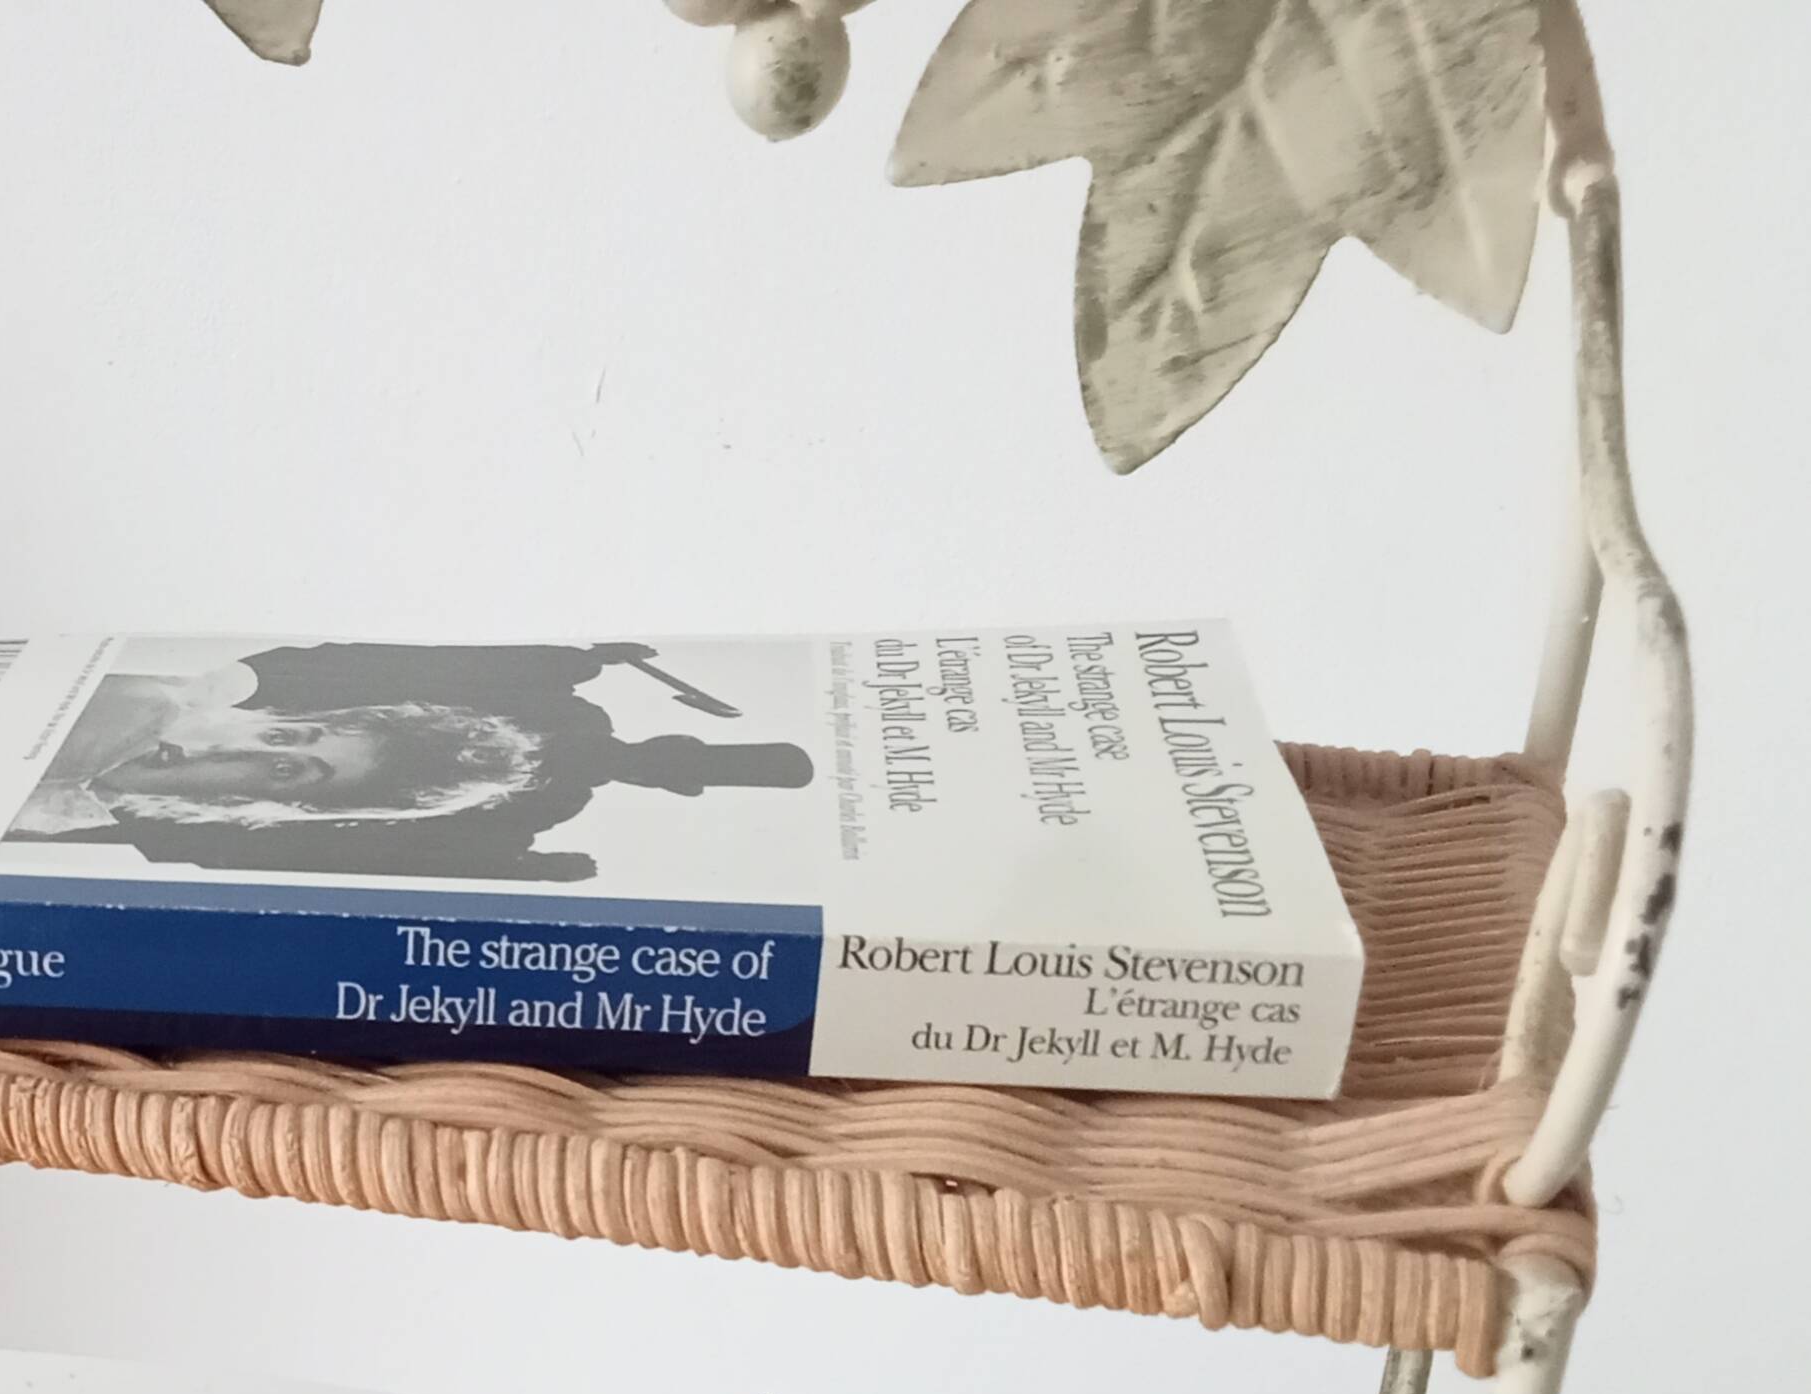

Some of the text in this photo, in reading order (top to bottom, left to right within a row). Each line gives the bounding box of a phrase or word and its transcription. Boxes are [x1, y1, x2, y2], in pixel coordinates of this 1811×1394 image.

[926, 637, 982, 733] L'étrange cas
[1067, 632, 1130, 760] The strange case
[861, 638, 938, 812] du Dr Jekyll et M. Hyde
[1001, 635, 1092, 826] of Dr Jekyll and Mr Hyde
[1135, 630, 1272, 918] Robert Louis Stevenson
[396, 925, 776, 983] The strange case of
[836, 934, 1306, 987] Robert Louis Stevenson
[336, 981, 766, 1044] Dr Jekyll and Mr Hyde
[911, 1022, 1293, 1073] du Dr Jekyll et M. Hyde
[1083, 987, 1301, 1030] L'étrange cas
